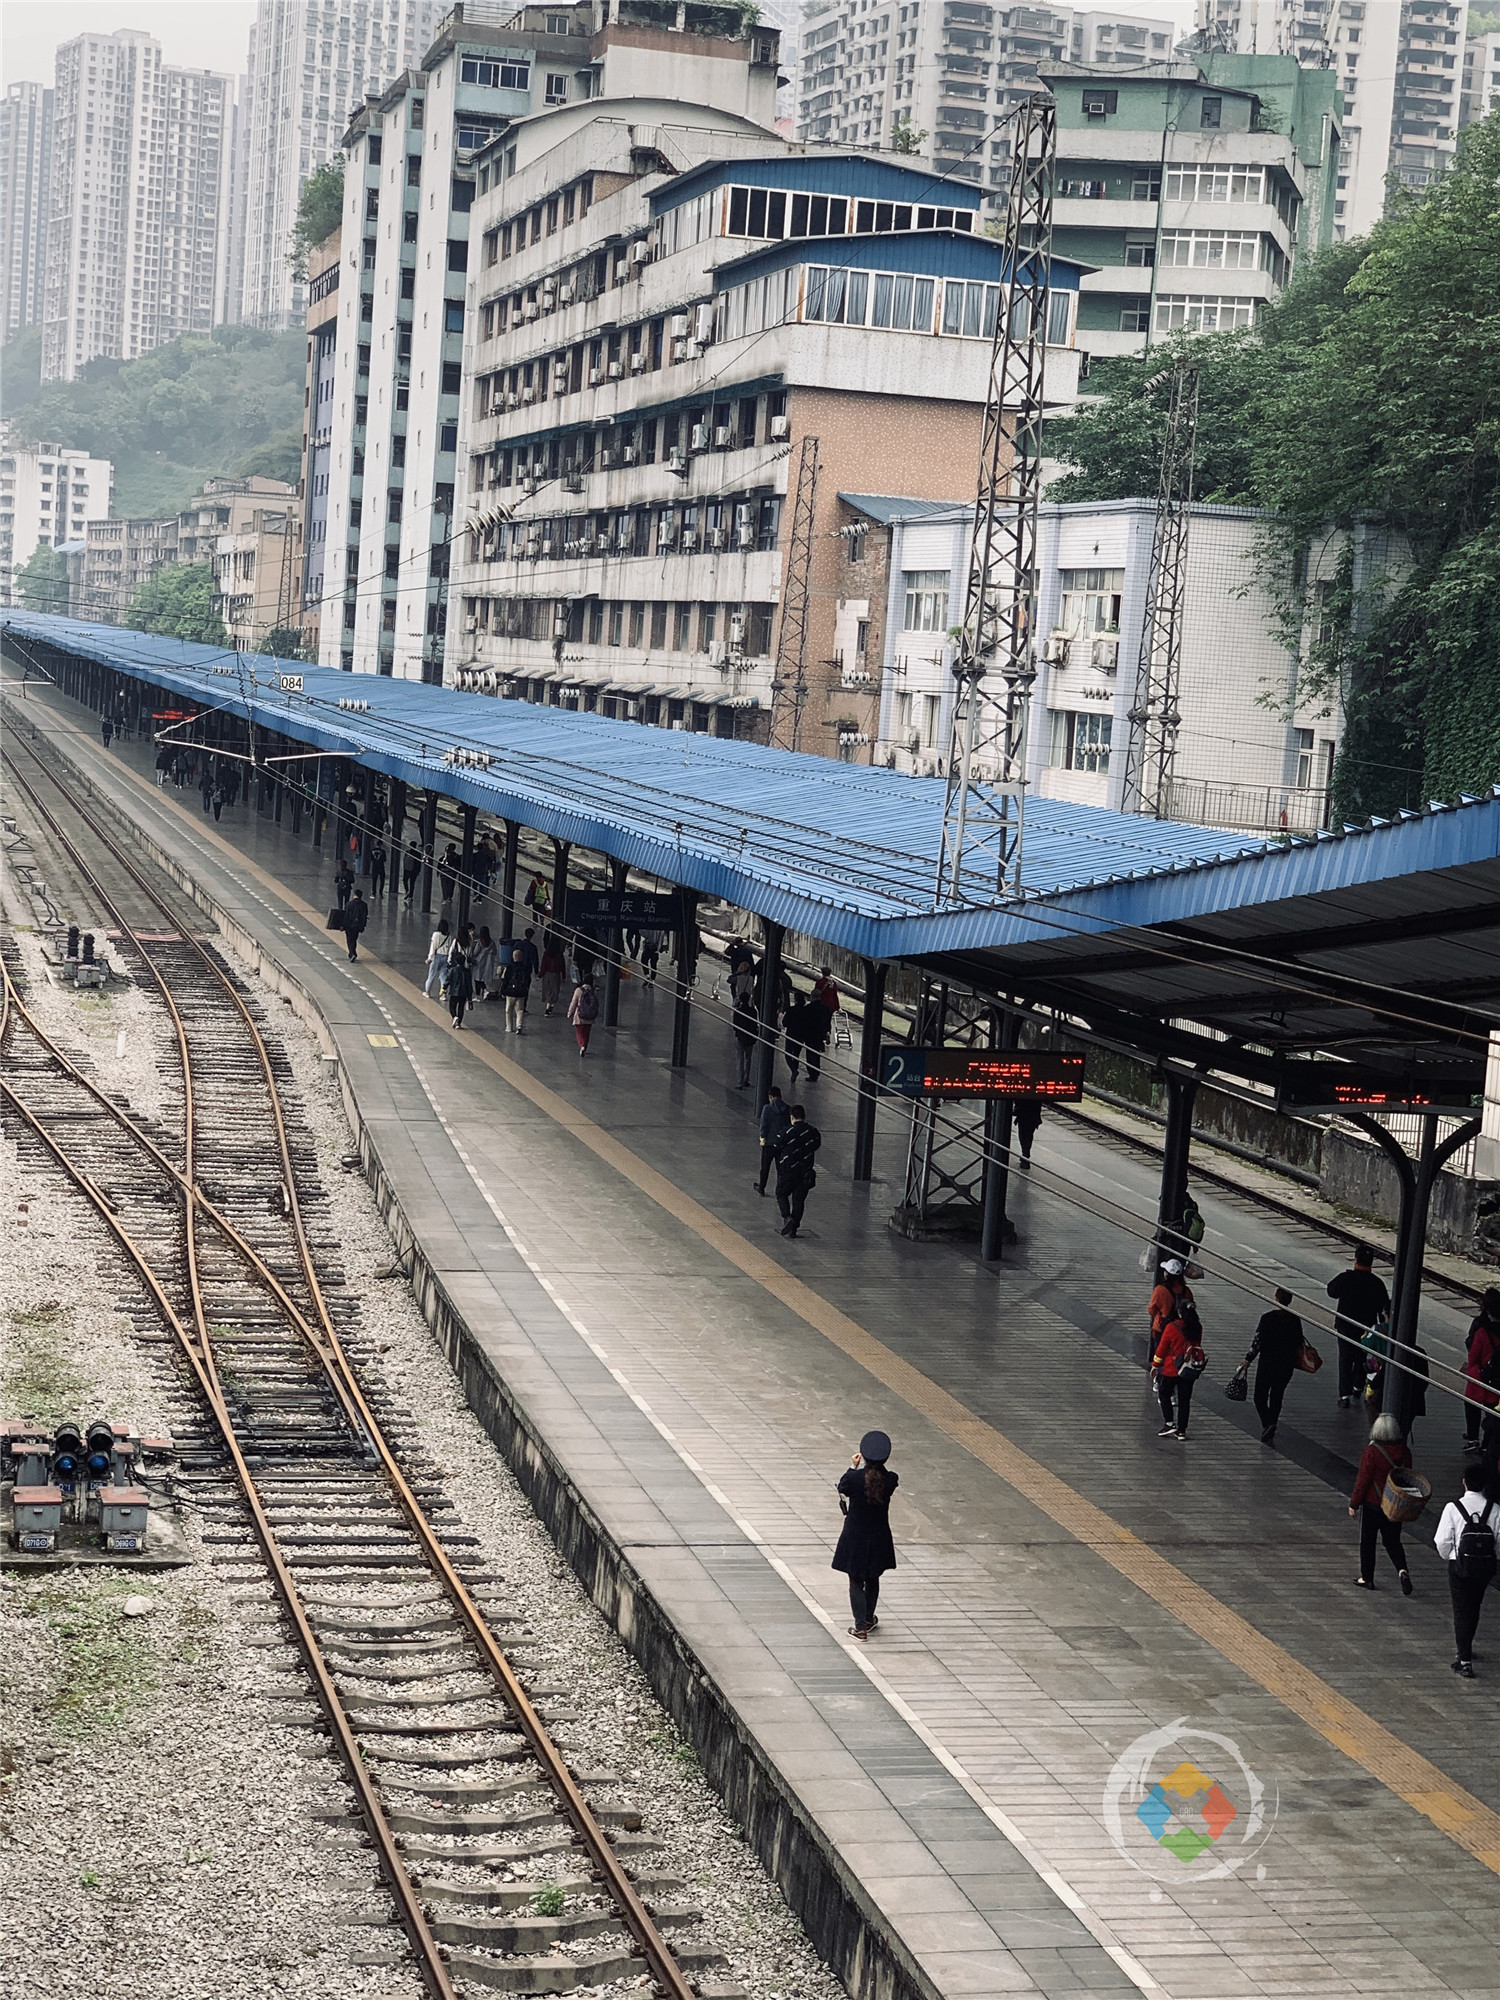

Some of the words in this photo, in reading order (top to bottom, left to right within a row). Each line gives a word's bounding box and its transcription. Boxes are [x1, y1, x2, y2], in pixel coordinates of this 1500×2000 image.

[281, 676, 303, 689] 084
[597, 898, 657, 913] 重庆站
[581, 912, 617, 922] Chongqing
[620, 914, 646, 923] Railway
[648, 915, 672, 923] Station
[886, 1055, 905, 1088] 2
